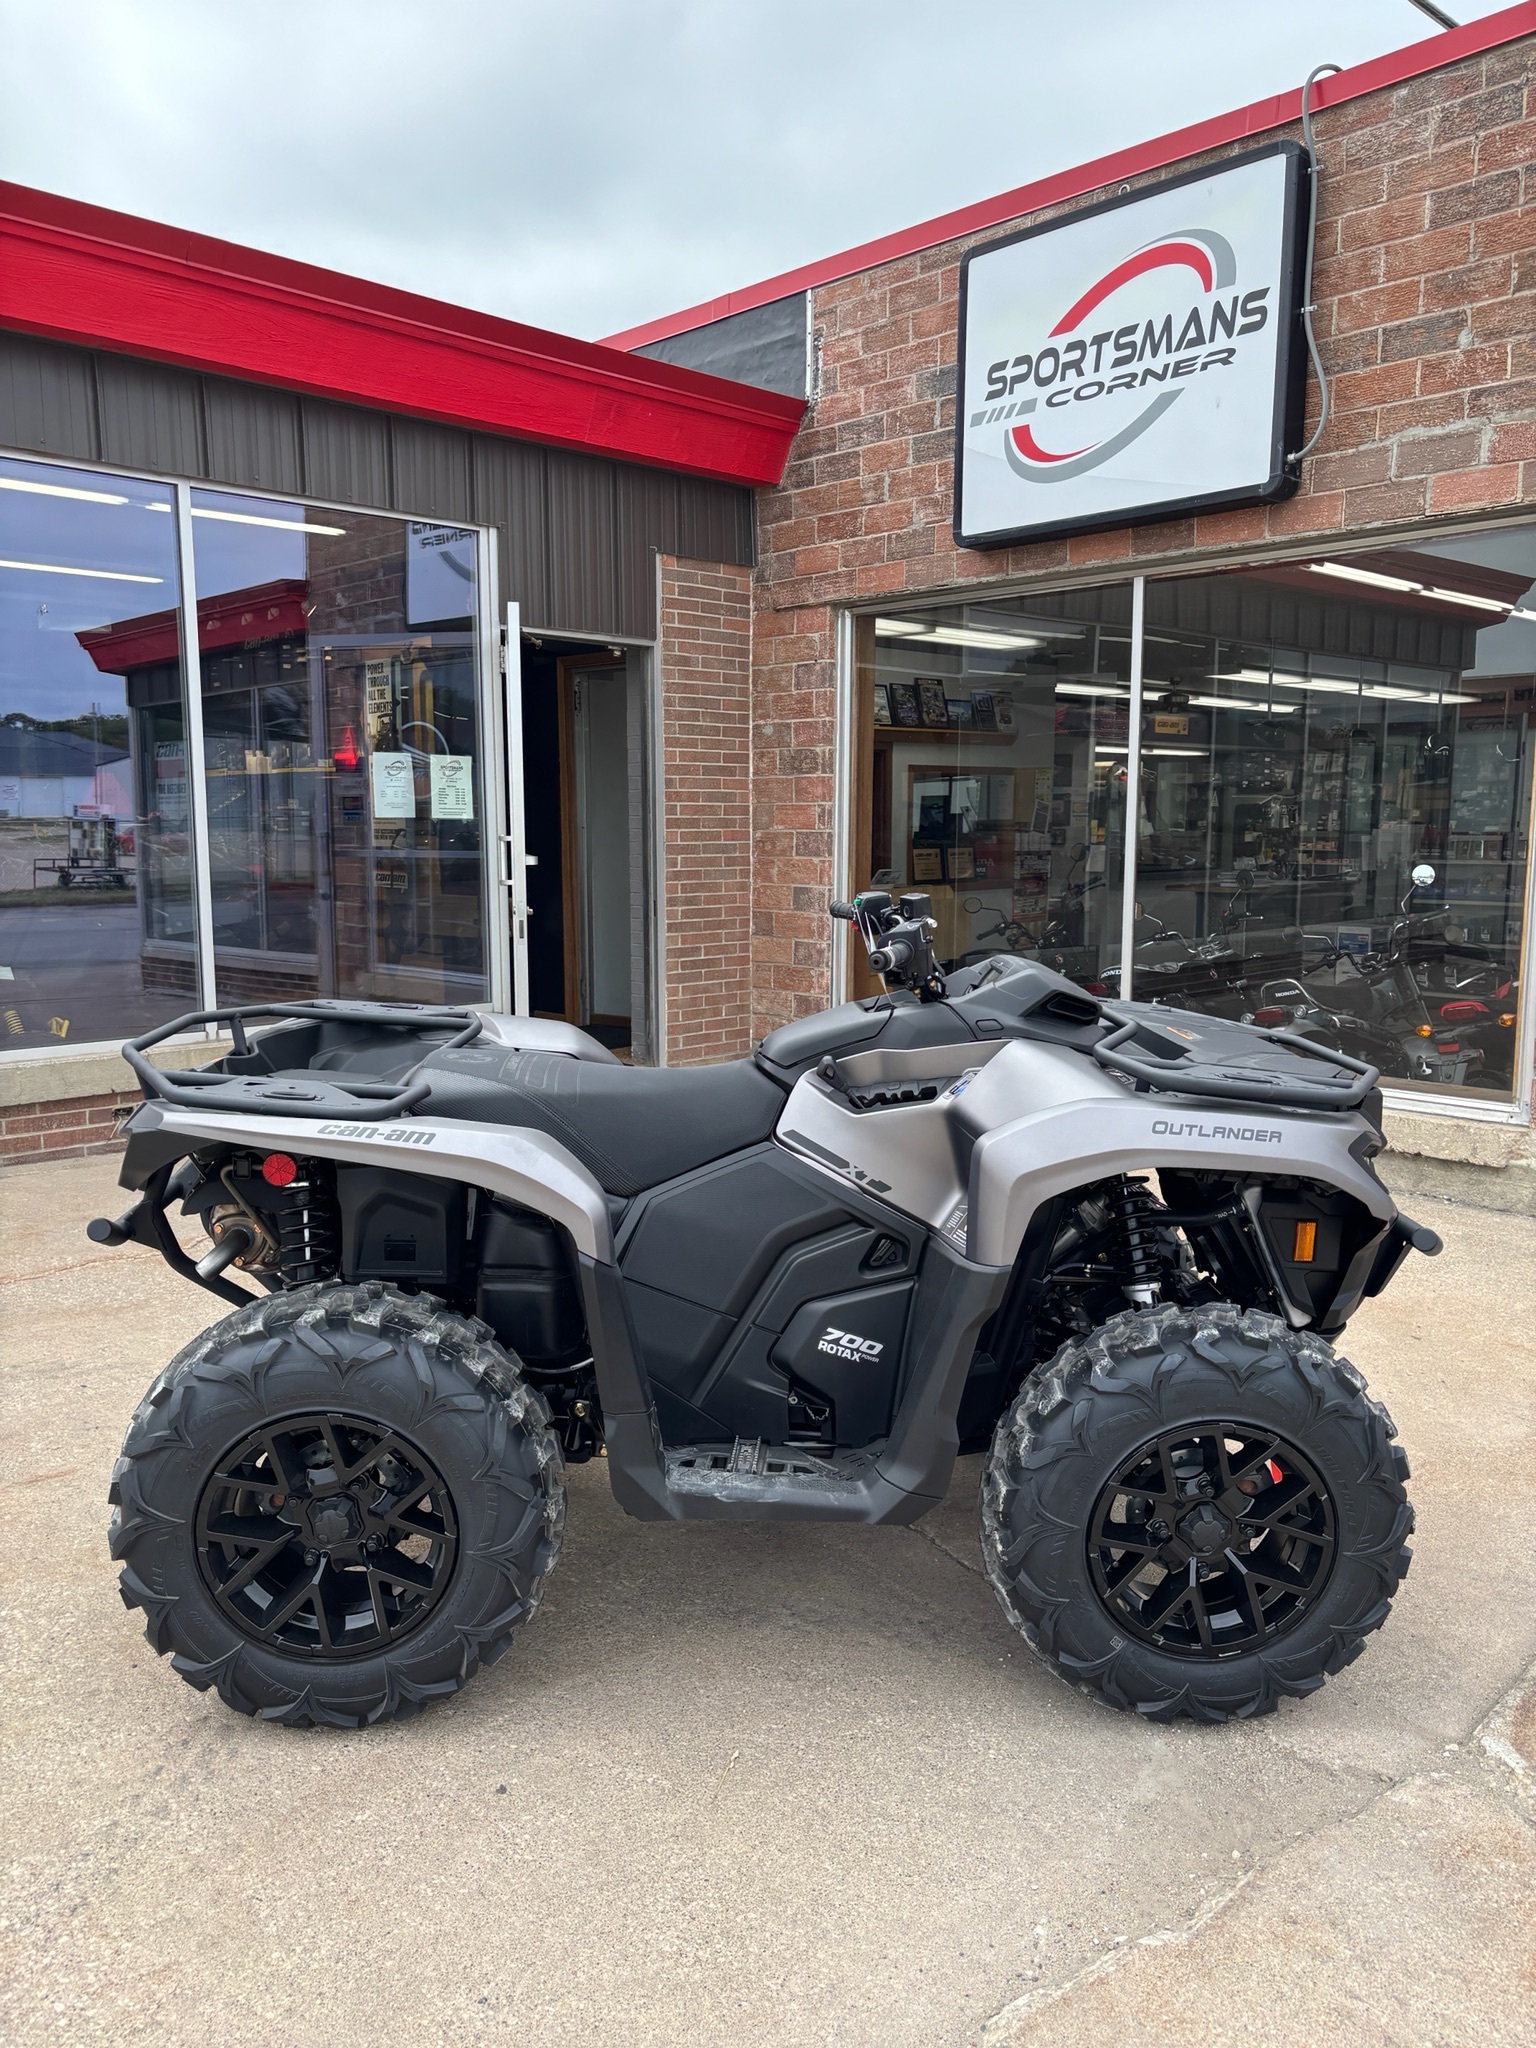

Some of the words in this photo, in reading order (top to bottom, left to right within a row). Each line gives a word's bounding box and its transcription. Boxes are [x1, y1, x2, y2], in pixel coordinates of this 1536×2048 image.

[985, 286, 1271, 402] SPORTSMANS
[1045, 347, 1237, 408] CORNER
[367, 663, 384, 674] POWER
[367, 676, 390, 687] THROUGH
[368, 689, 377, 700] ALL
[377, 688, 386, 700] THE
[368, 701, 393, 714] ELEMENTS
[156, 743, 185, 758] can-
[376, 873, 406, 883] canam
[1100, 970, 1122, 979] HOND
[1274, 989, 1301, 998] HONDA
[317, 1124, 437, 1145] can-am
[821, 1327, 884, 1355] 700
[817, 1340, 862, 1363] ROTAX
[860, 1353, 880, 1363] POWER
